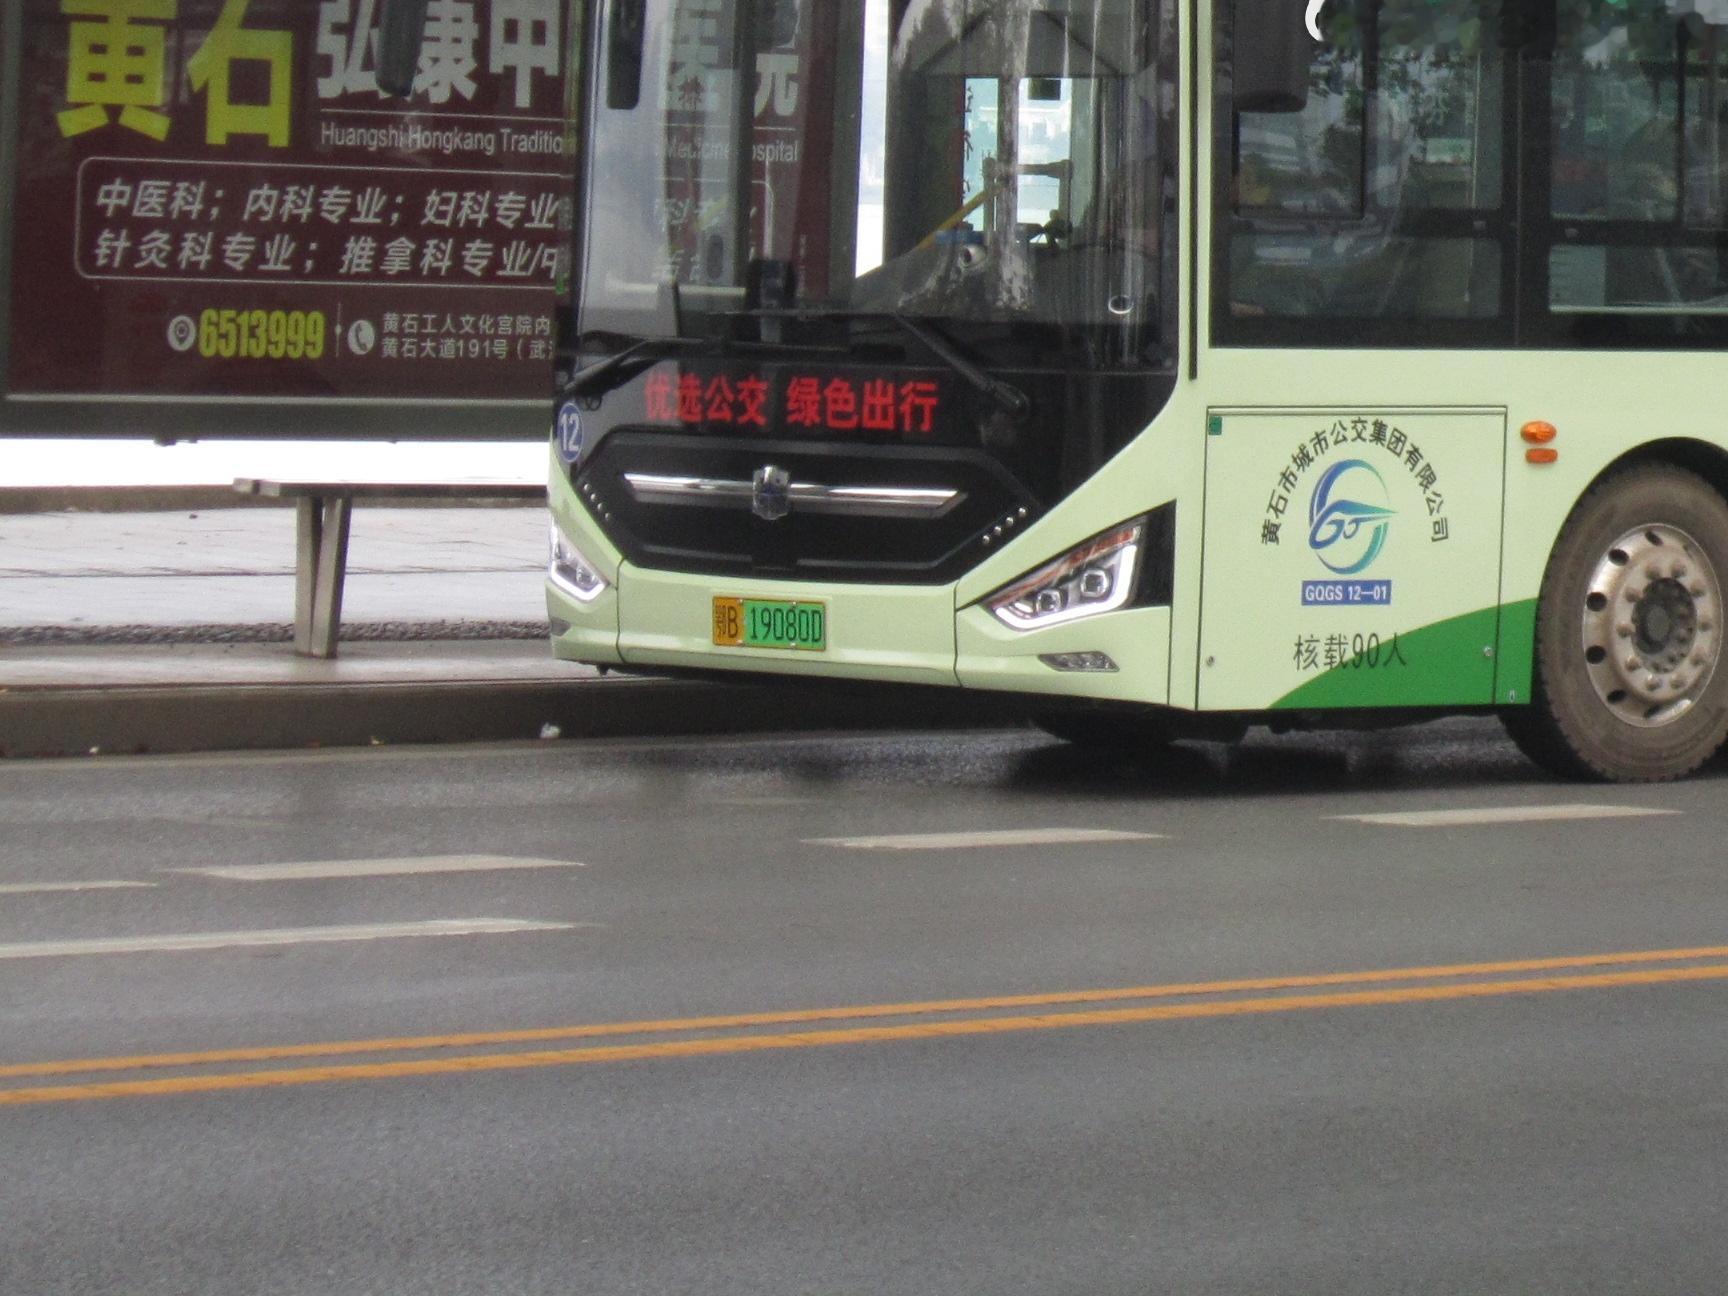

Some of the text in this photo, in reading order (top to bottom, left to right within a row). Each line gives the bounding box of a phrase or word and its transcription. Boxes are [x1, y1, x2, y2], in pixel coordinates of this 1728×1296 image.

[321, 122, 403, 151] Huangshi
[409, 124, 496, 155] Hongkang
[752, 141, 798, 161] spital
[199, 308, 325, 359] 6513999
[383, 312, 551, 335] 黄石工人文化宫院内
[381, 337, 555, 360] 黄石大道191号（武
[786, 376, 938, 432] 绿色出行
[560, 413, 580, 452] 12
[1261, 416, 1449, 545] 黄石市城市公交集团有限公司
[1293, 632, 1407, 671] 核载90人
